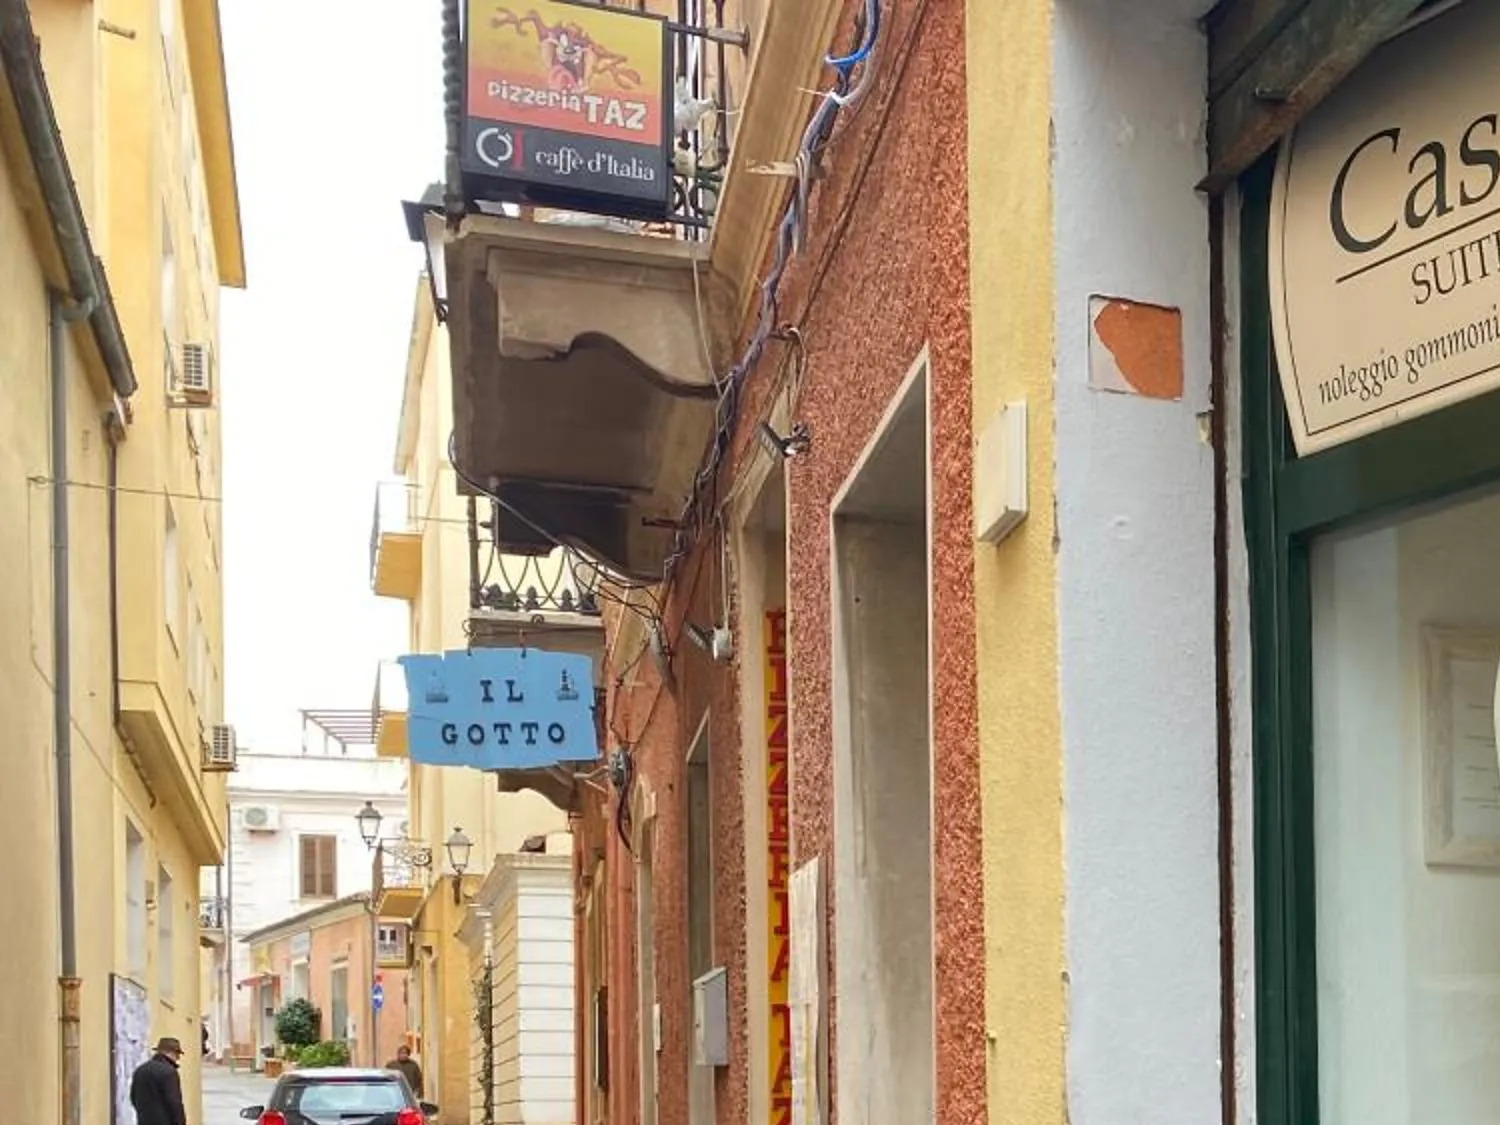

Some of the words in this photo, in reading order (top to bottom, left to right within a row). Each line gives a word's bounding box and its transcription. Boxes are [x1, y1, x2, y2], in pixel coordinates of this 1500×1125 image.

[487, 80, 582, 113] pizzeria
[583, 95, 649, 132] TAZ
[535, 146, 583, 175] caffè
[586, 150, 656, 182] d'Italia
[1318, 347, 1400, 405] noleggio
[480, 679, 524, 703] IL
[441, 722, 566, 745] GOTTO
